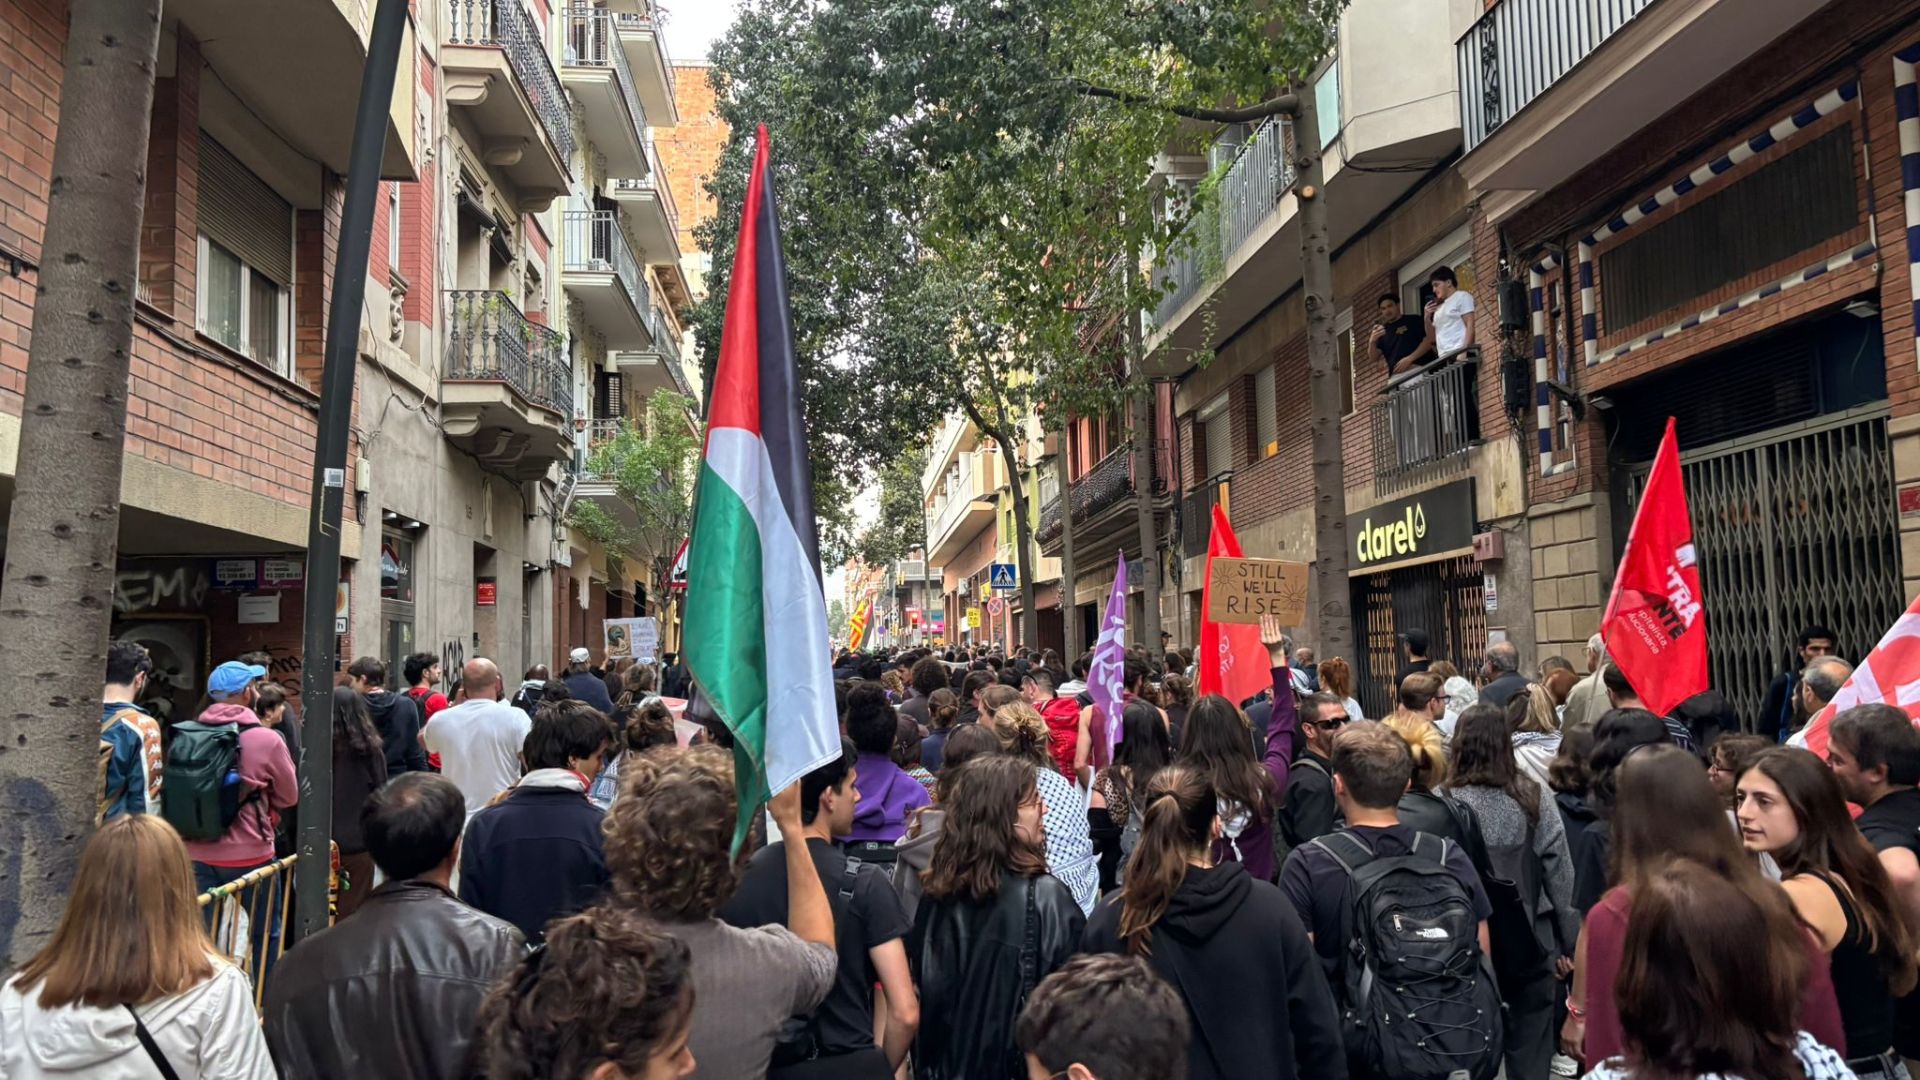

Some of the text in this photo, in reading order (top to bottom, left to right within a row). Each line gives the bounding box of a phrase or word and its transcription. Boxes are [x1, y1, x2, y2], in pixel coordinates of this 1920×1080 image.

[1357, 506, 1416, 562] clarel
[1237, 563, 1286, 580] STILL
[1243, 581, 1281, 594] WE'LL
[1226, 595, 1281, 615] RISE
[1666, 565, 1701, 628] TRA
[1626, 612, 1660, 655] lucionaria
[1637, 609, 1669, 649] pitalista.
[1651, 602, 1688, 641] NTE
